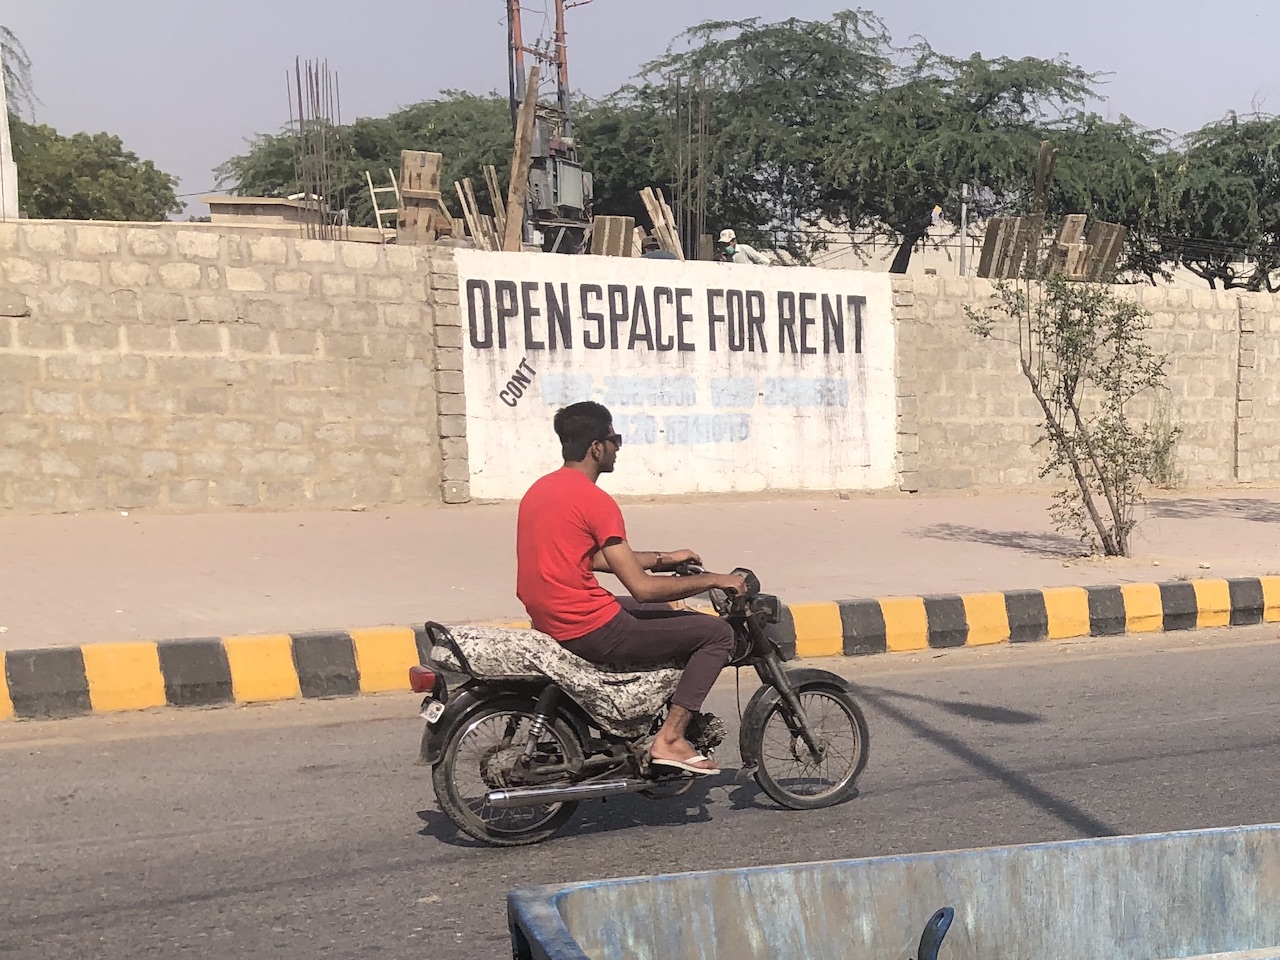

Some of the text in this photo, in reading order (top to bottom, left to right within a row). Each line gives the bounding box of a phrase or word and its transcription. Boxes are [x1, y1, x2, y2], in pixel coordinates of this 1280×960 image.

[466, 279, 867, 354] OPEN SPACE FOR RENT
[499, 357, 536, 407] CONT
